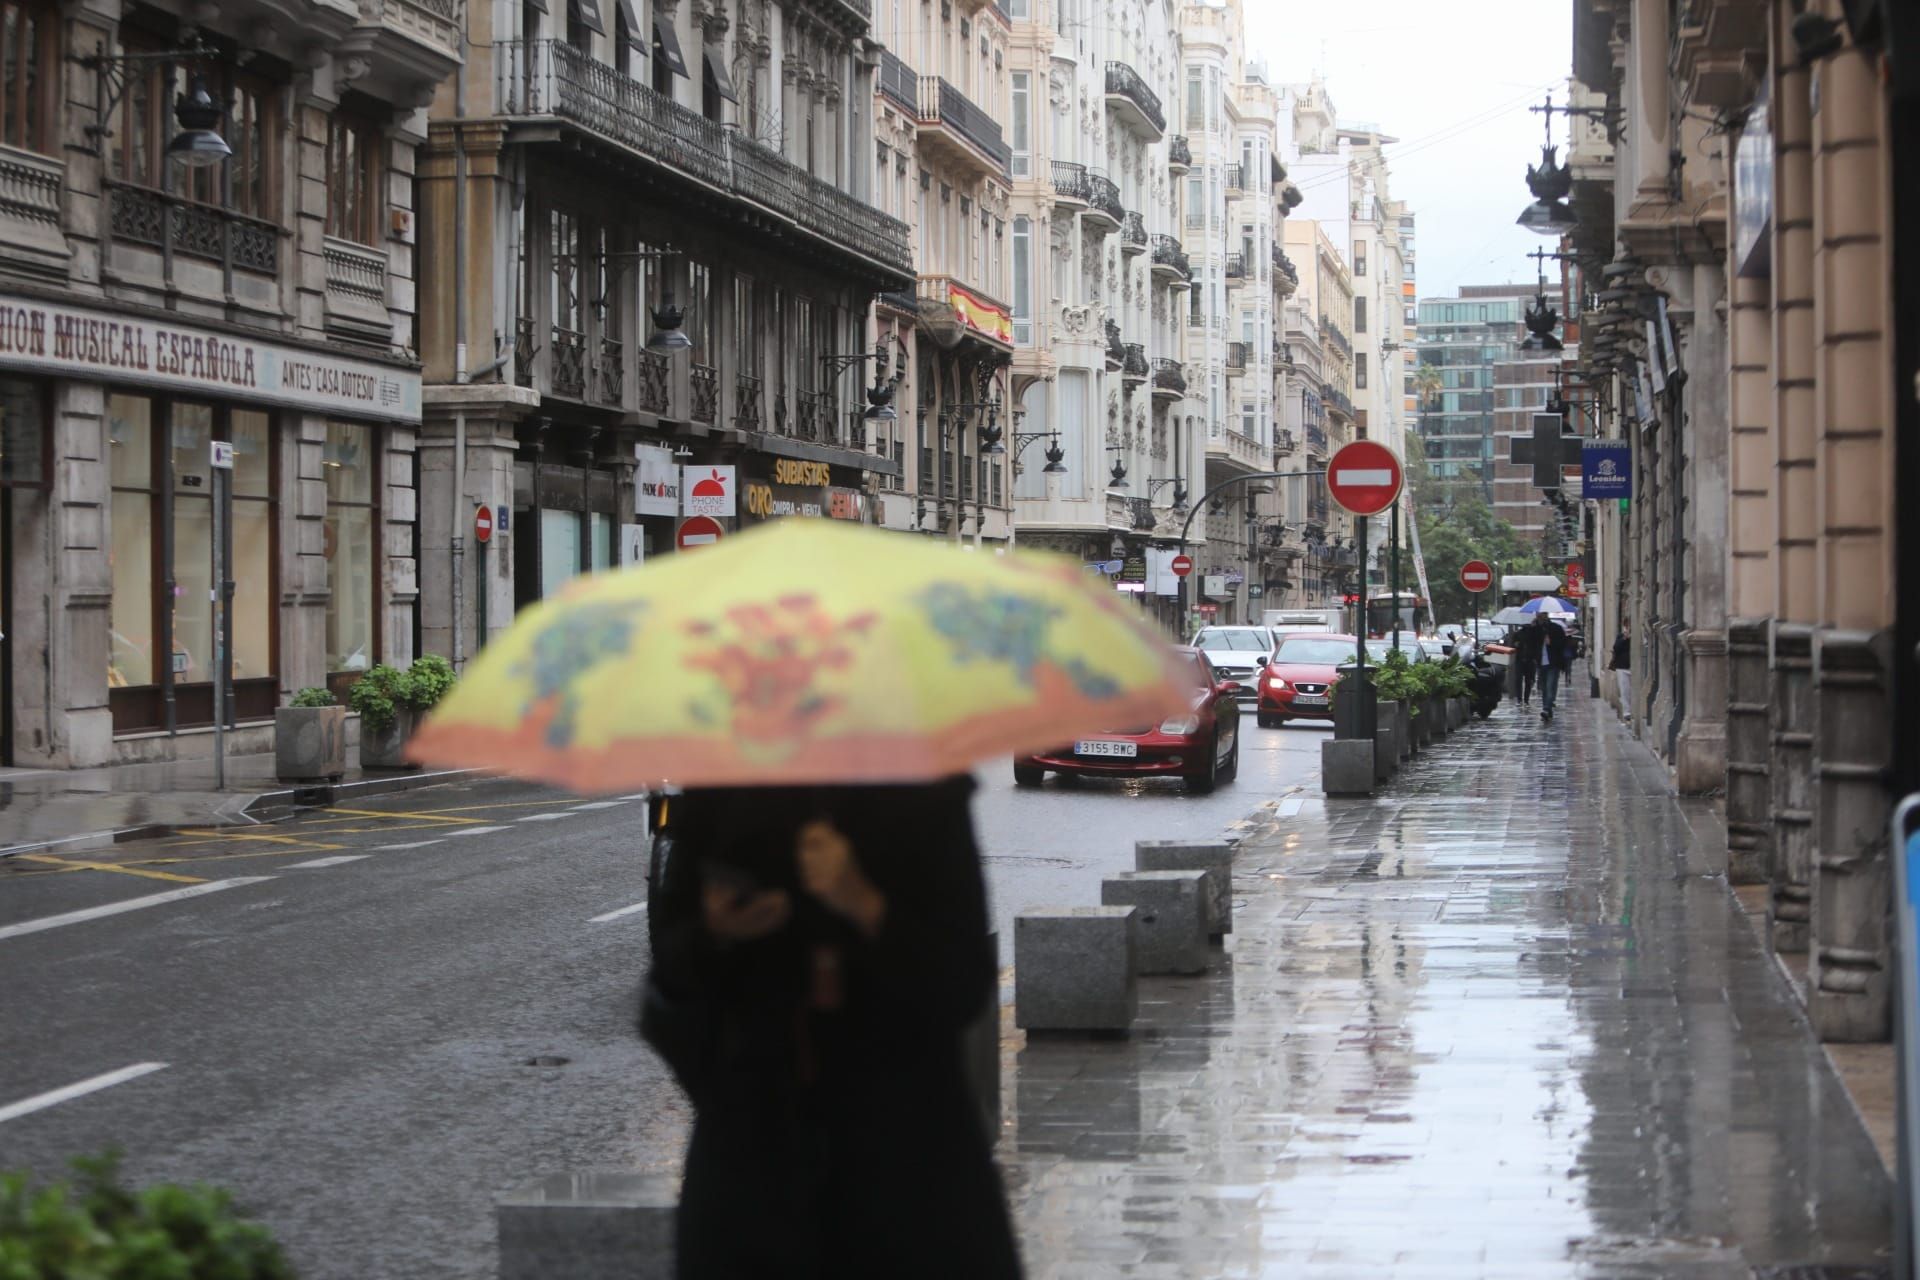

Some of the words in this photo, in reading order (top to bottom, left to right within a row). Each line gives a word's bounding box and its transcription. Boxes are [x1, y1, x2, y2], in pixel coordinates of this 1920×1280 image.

[54, 313, 149, 370] MUSICAL
[156, 330, 256, 388] ESPAÑOLA
[282, 360, 311, 391] ANTES
[776, 458, 830, 487] SUBASTAS
[692, 496, 725, 505] PHONE
[693, 505, 724, 514] TASTIC
[748, 484, 773, 519] ORO
[802, 503, 822, 517] VENTA
[1083, 742, 1109, 753] 3155
